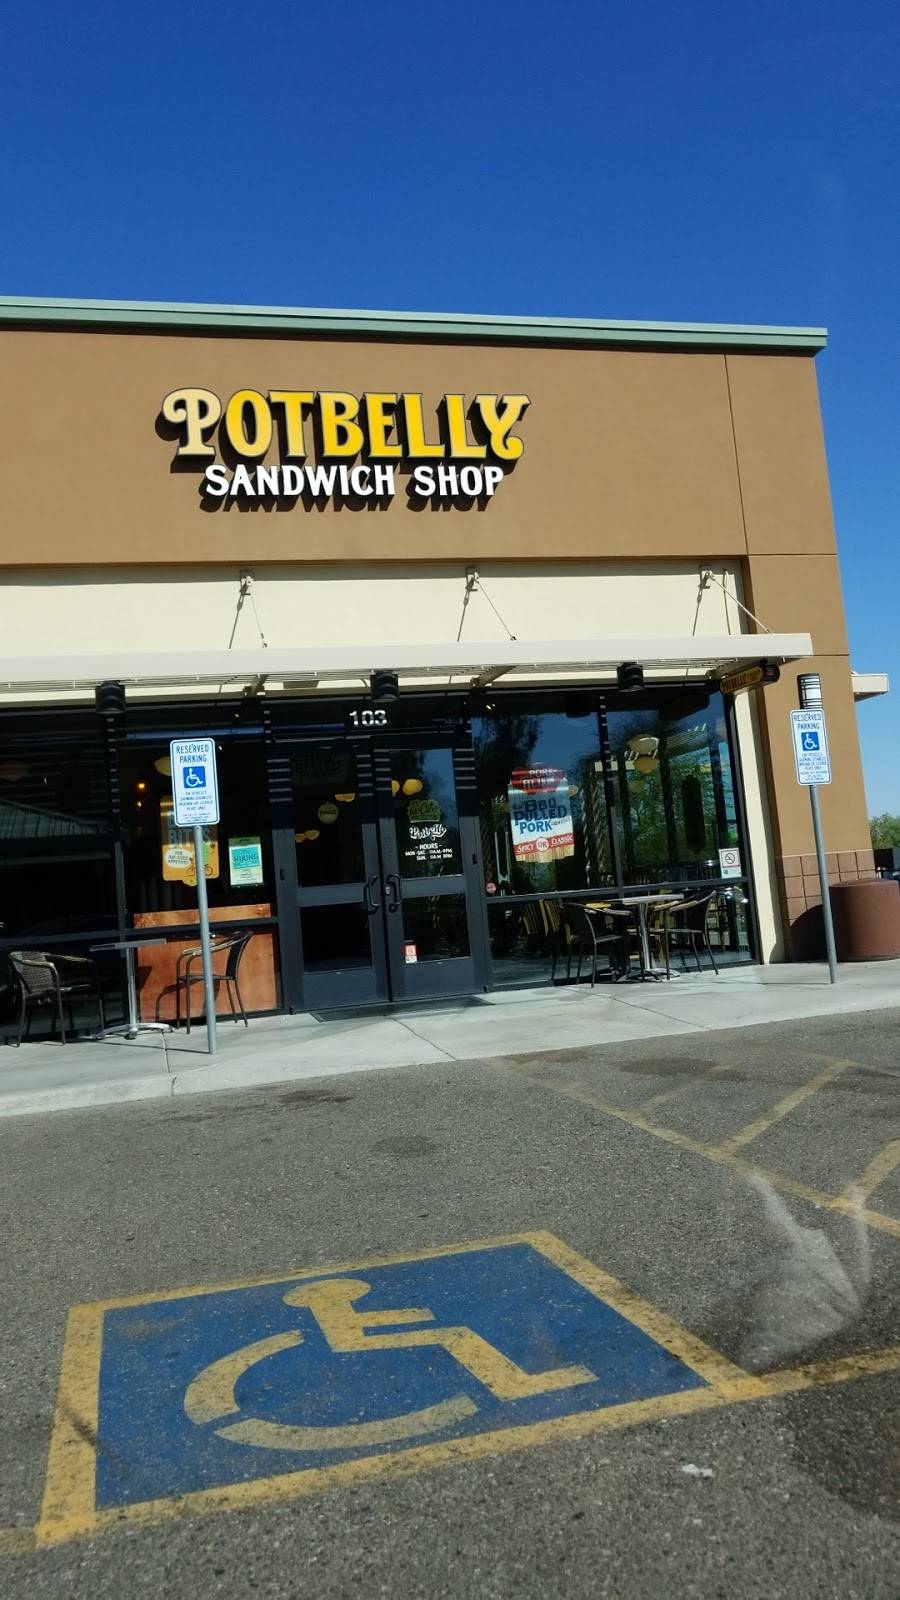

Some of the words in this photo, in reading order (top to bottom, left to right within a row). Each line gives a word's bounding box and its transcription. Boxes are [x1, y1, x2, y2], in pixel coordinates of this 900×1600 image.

[161, 387, 532, 461] POTBELLY
[204, 464, 396, 497] SANDWICH
[414, 465, 504, 497] SHOP
[349, 709, 388, 727] 103
[793, 713, 822, 722] RESERVED
[176, 744, 209, 754] RESERVED
[179, 753, 208, 764] PARKING
[513, 805, 568, 826] PULLED
[519, 819, 553, 835] PORK
[537, 840, 547, 849] OR
[232, 853, 259, 864] HIRING
